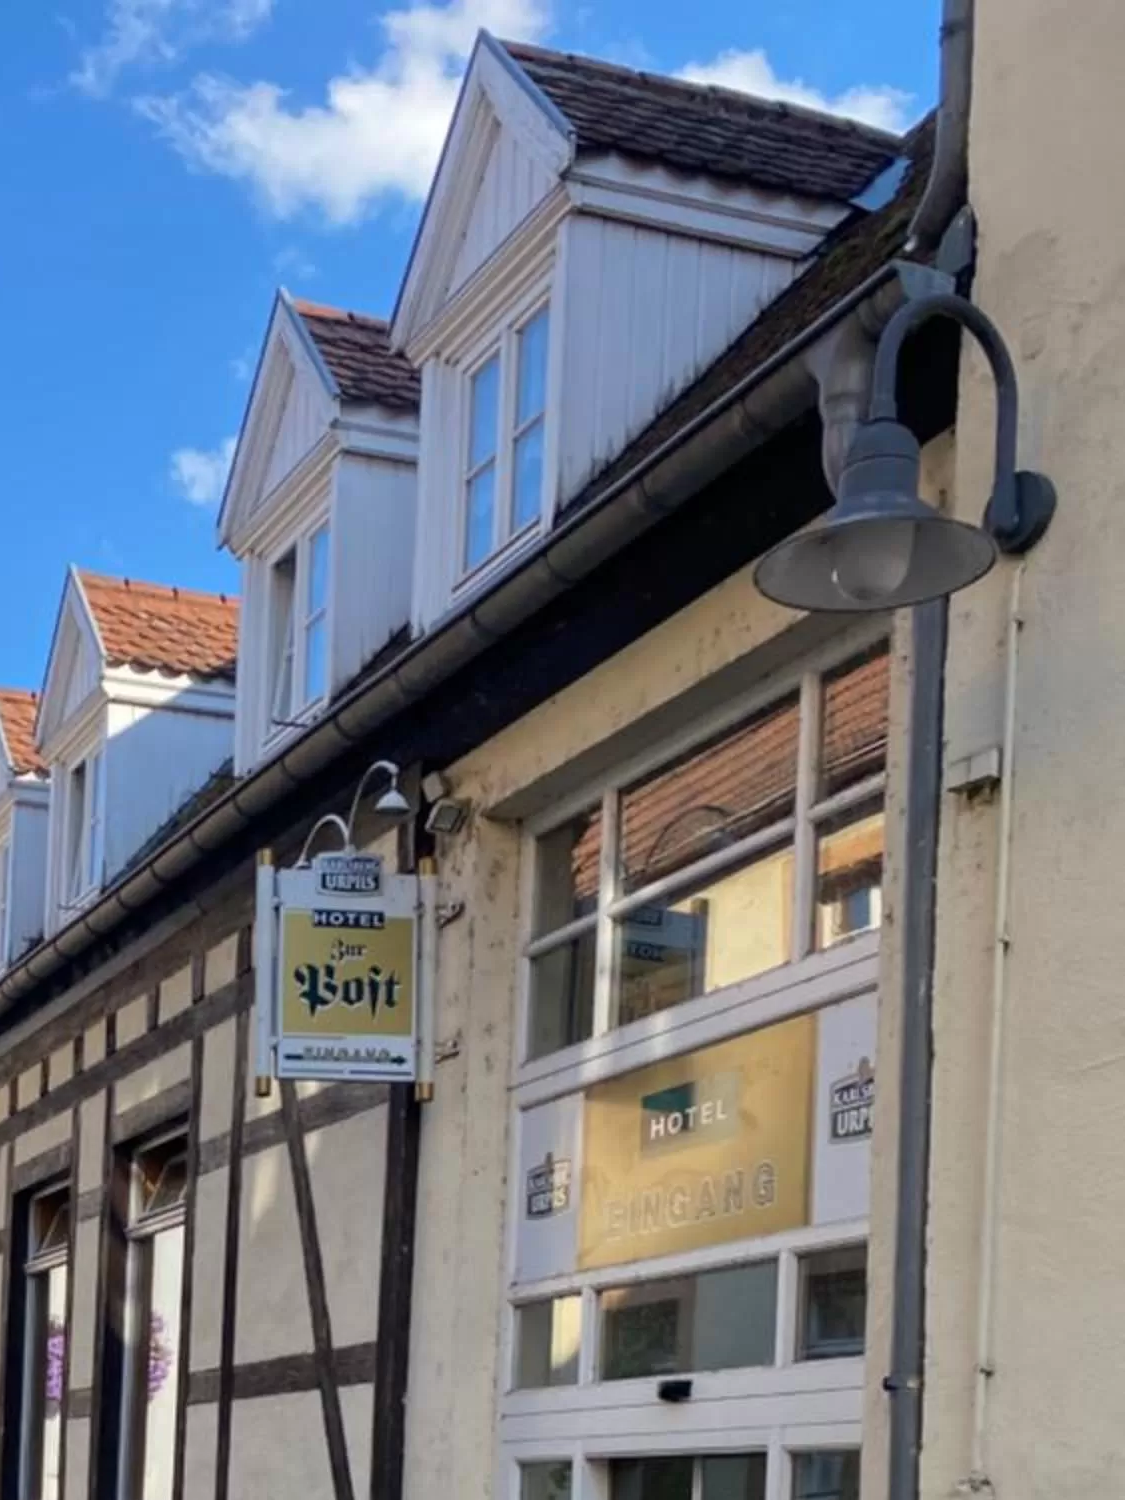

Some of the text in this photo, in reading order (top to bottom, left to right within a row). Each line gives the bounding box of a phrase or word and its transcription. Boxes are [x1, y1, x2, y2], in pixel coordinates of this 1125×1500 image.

[314, 911, 383, 927] HOTEL
[330, 938, 367, 961] Zur
[650, 1099, 728, 1141] HOTEL
[606, 1160, 776, 1242] EINGANG
